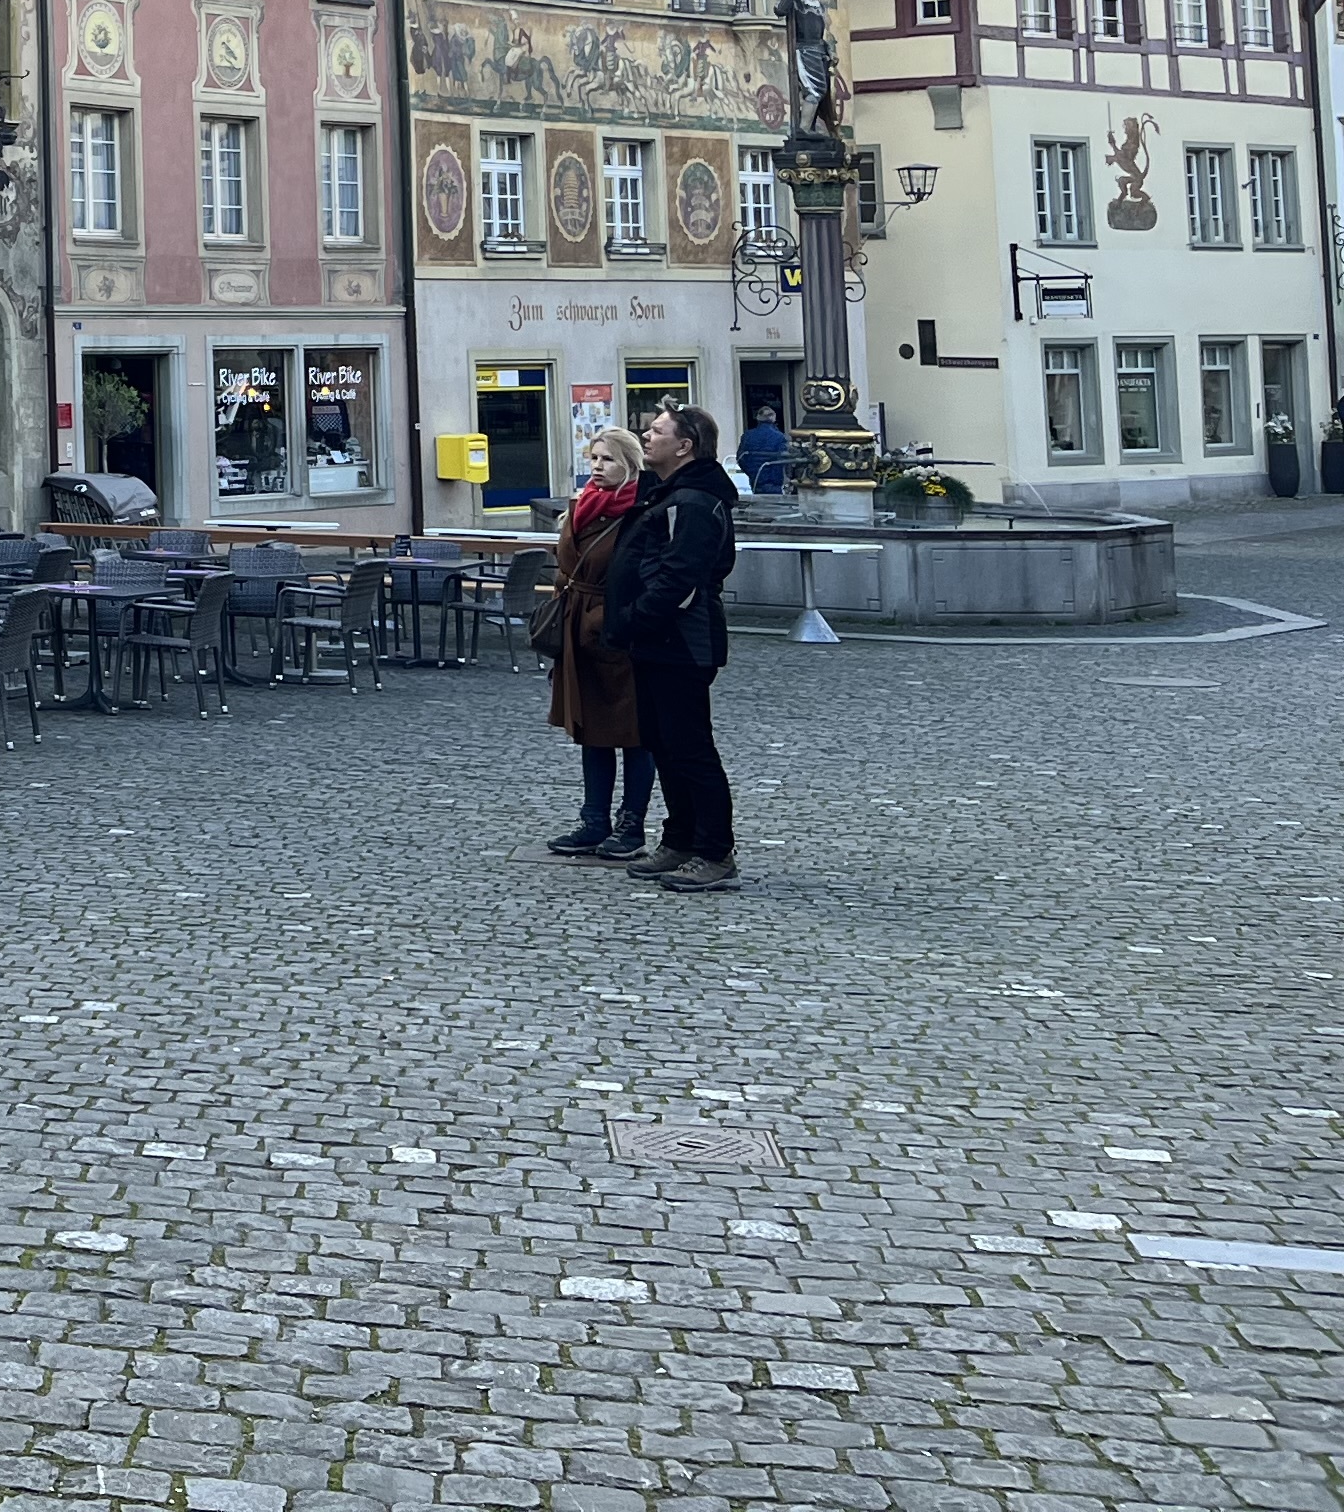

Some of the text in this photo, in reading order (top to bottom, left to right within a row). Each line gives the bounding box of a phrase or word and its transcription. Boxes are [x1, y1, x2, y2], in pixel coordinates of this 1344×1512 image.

[508, 294, 665, 331] Zum schwarzen Horn
[219, 367, 276, 386] River Bike
[308, 366, 362, 385] River Bike
